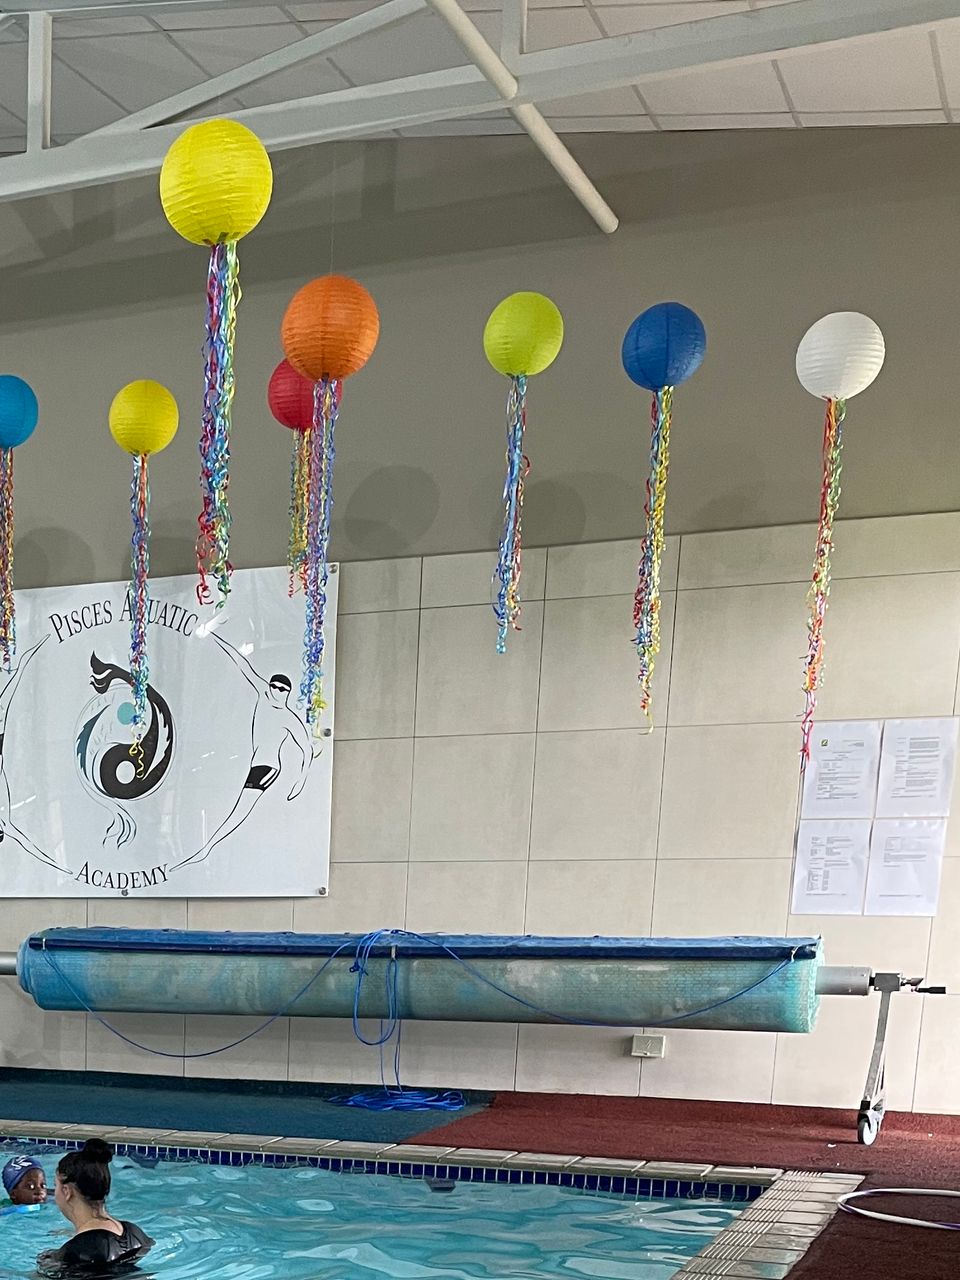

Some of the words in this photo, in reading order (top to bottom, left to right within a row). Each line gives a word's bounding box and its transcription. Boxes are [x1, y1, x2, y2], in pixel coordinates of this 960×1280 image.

[48, 600, 113, 644] PISCES
[119, 588, 199, 637] AUATIC
[74, 861, 169, 890] ACADEMY
